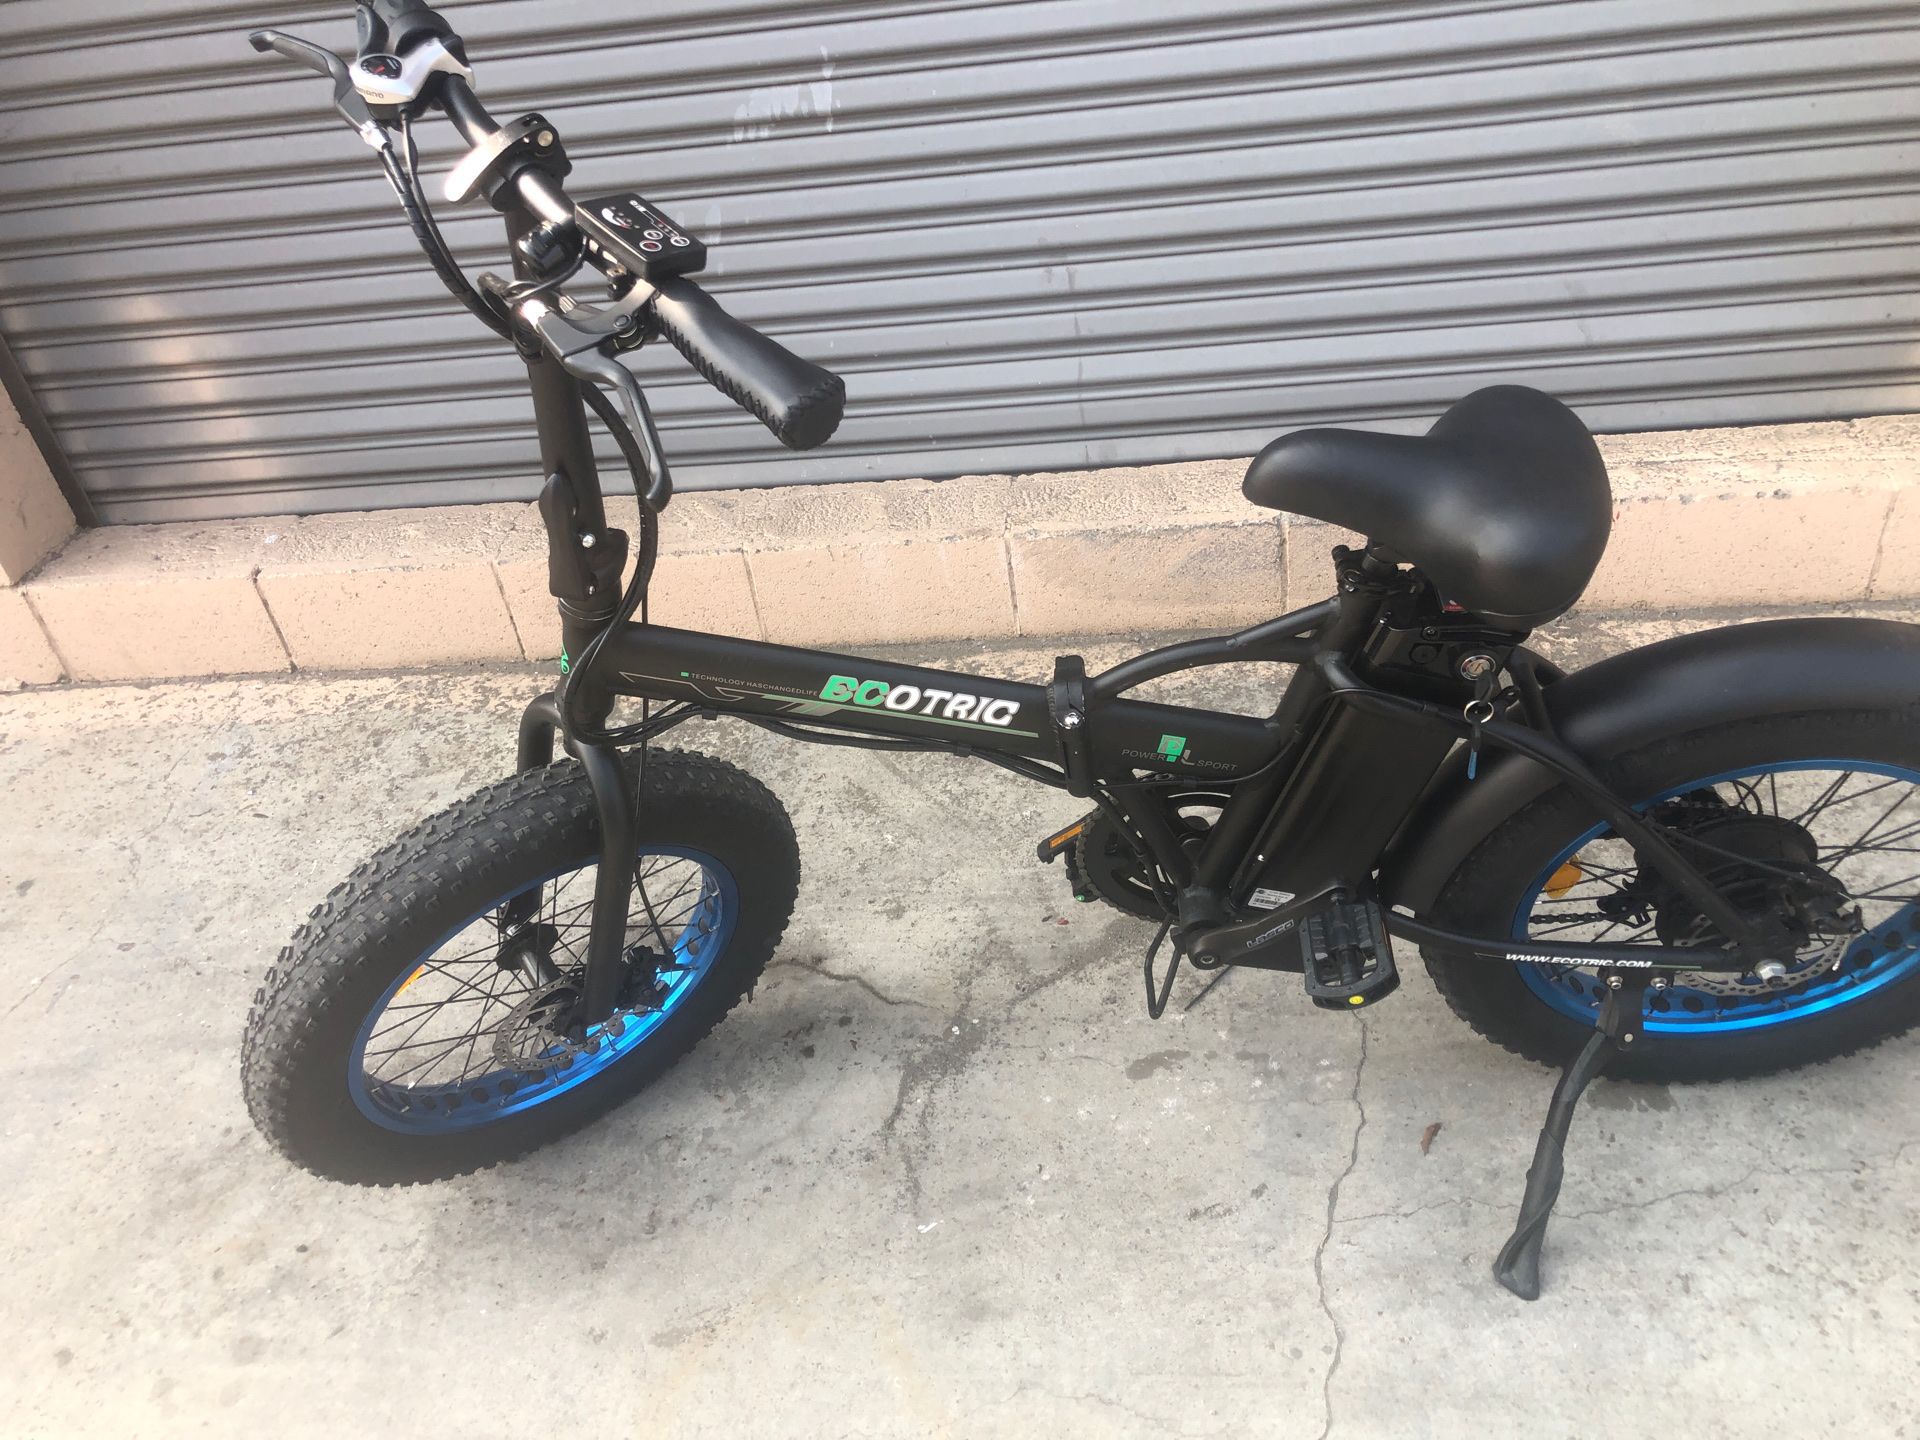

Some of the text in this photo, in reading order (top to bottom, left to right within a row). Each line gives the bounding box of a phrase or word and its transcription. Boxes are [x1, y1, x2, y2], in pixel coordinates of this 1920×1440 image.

[691, 673, 745, 687] TECHNOLOGY
[819, 675, 1021, 727] ECOTRIC
[1121, 749, 1166, 761] POWER
[1197, 760, 1238, 772] SPORT
[1505, 953, 1653, 969] WWW.ECOTRIC.COM
